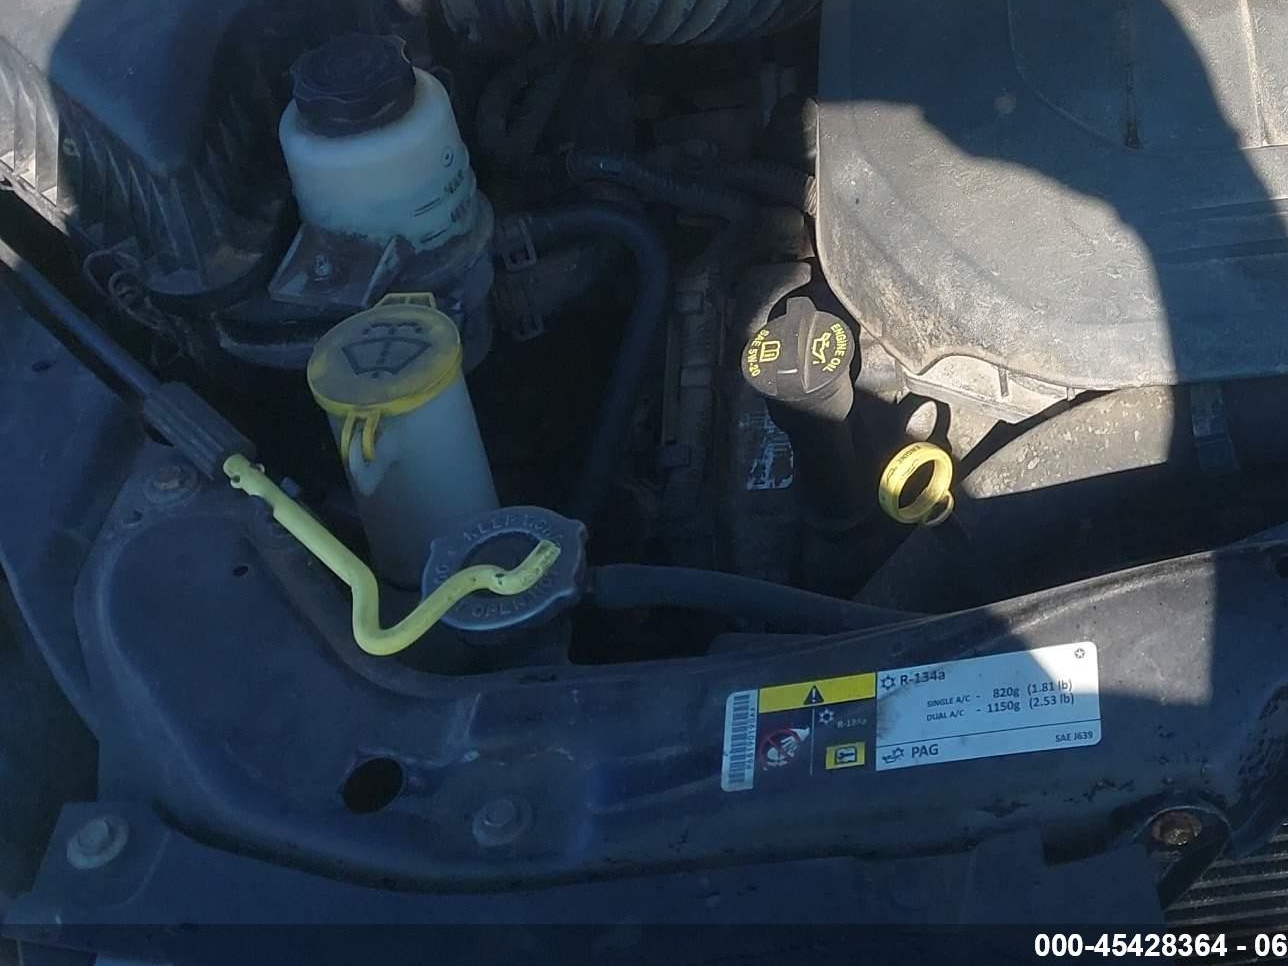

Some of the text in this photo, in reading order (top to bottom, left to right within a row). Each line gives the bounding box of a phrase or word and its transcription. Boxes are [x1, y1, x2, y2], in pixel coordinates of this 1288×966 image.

[747, 329, 770, 378] SAE 5W-20
[822, 323, 848, 372] ENGINE OIL
[899, 669, 946, 686] R-134a
[926, 698, 954, 708] SINGLE
[955, 694, 971, 705] A/C
[992, 685, 1020, 702] 820g
[1027, 681, 1056, 696] (1.81
[1057, 679, 1073, 693] lb)
[926, 711, 948, 722] DUAL
[949, 708, 965, 720] A/C
[986, 698, 1020, 715] 1150g
[1028, 695, 1058, 710] (2.53
[1058, 693, 1075, 708] lb)
[911, 744, 939, 759] PAG
[1055, 732, 1072, 744] SAE
